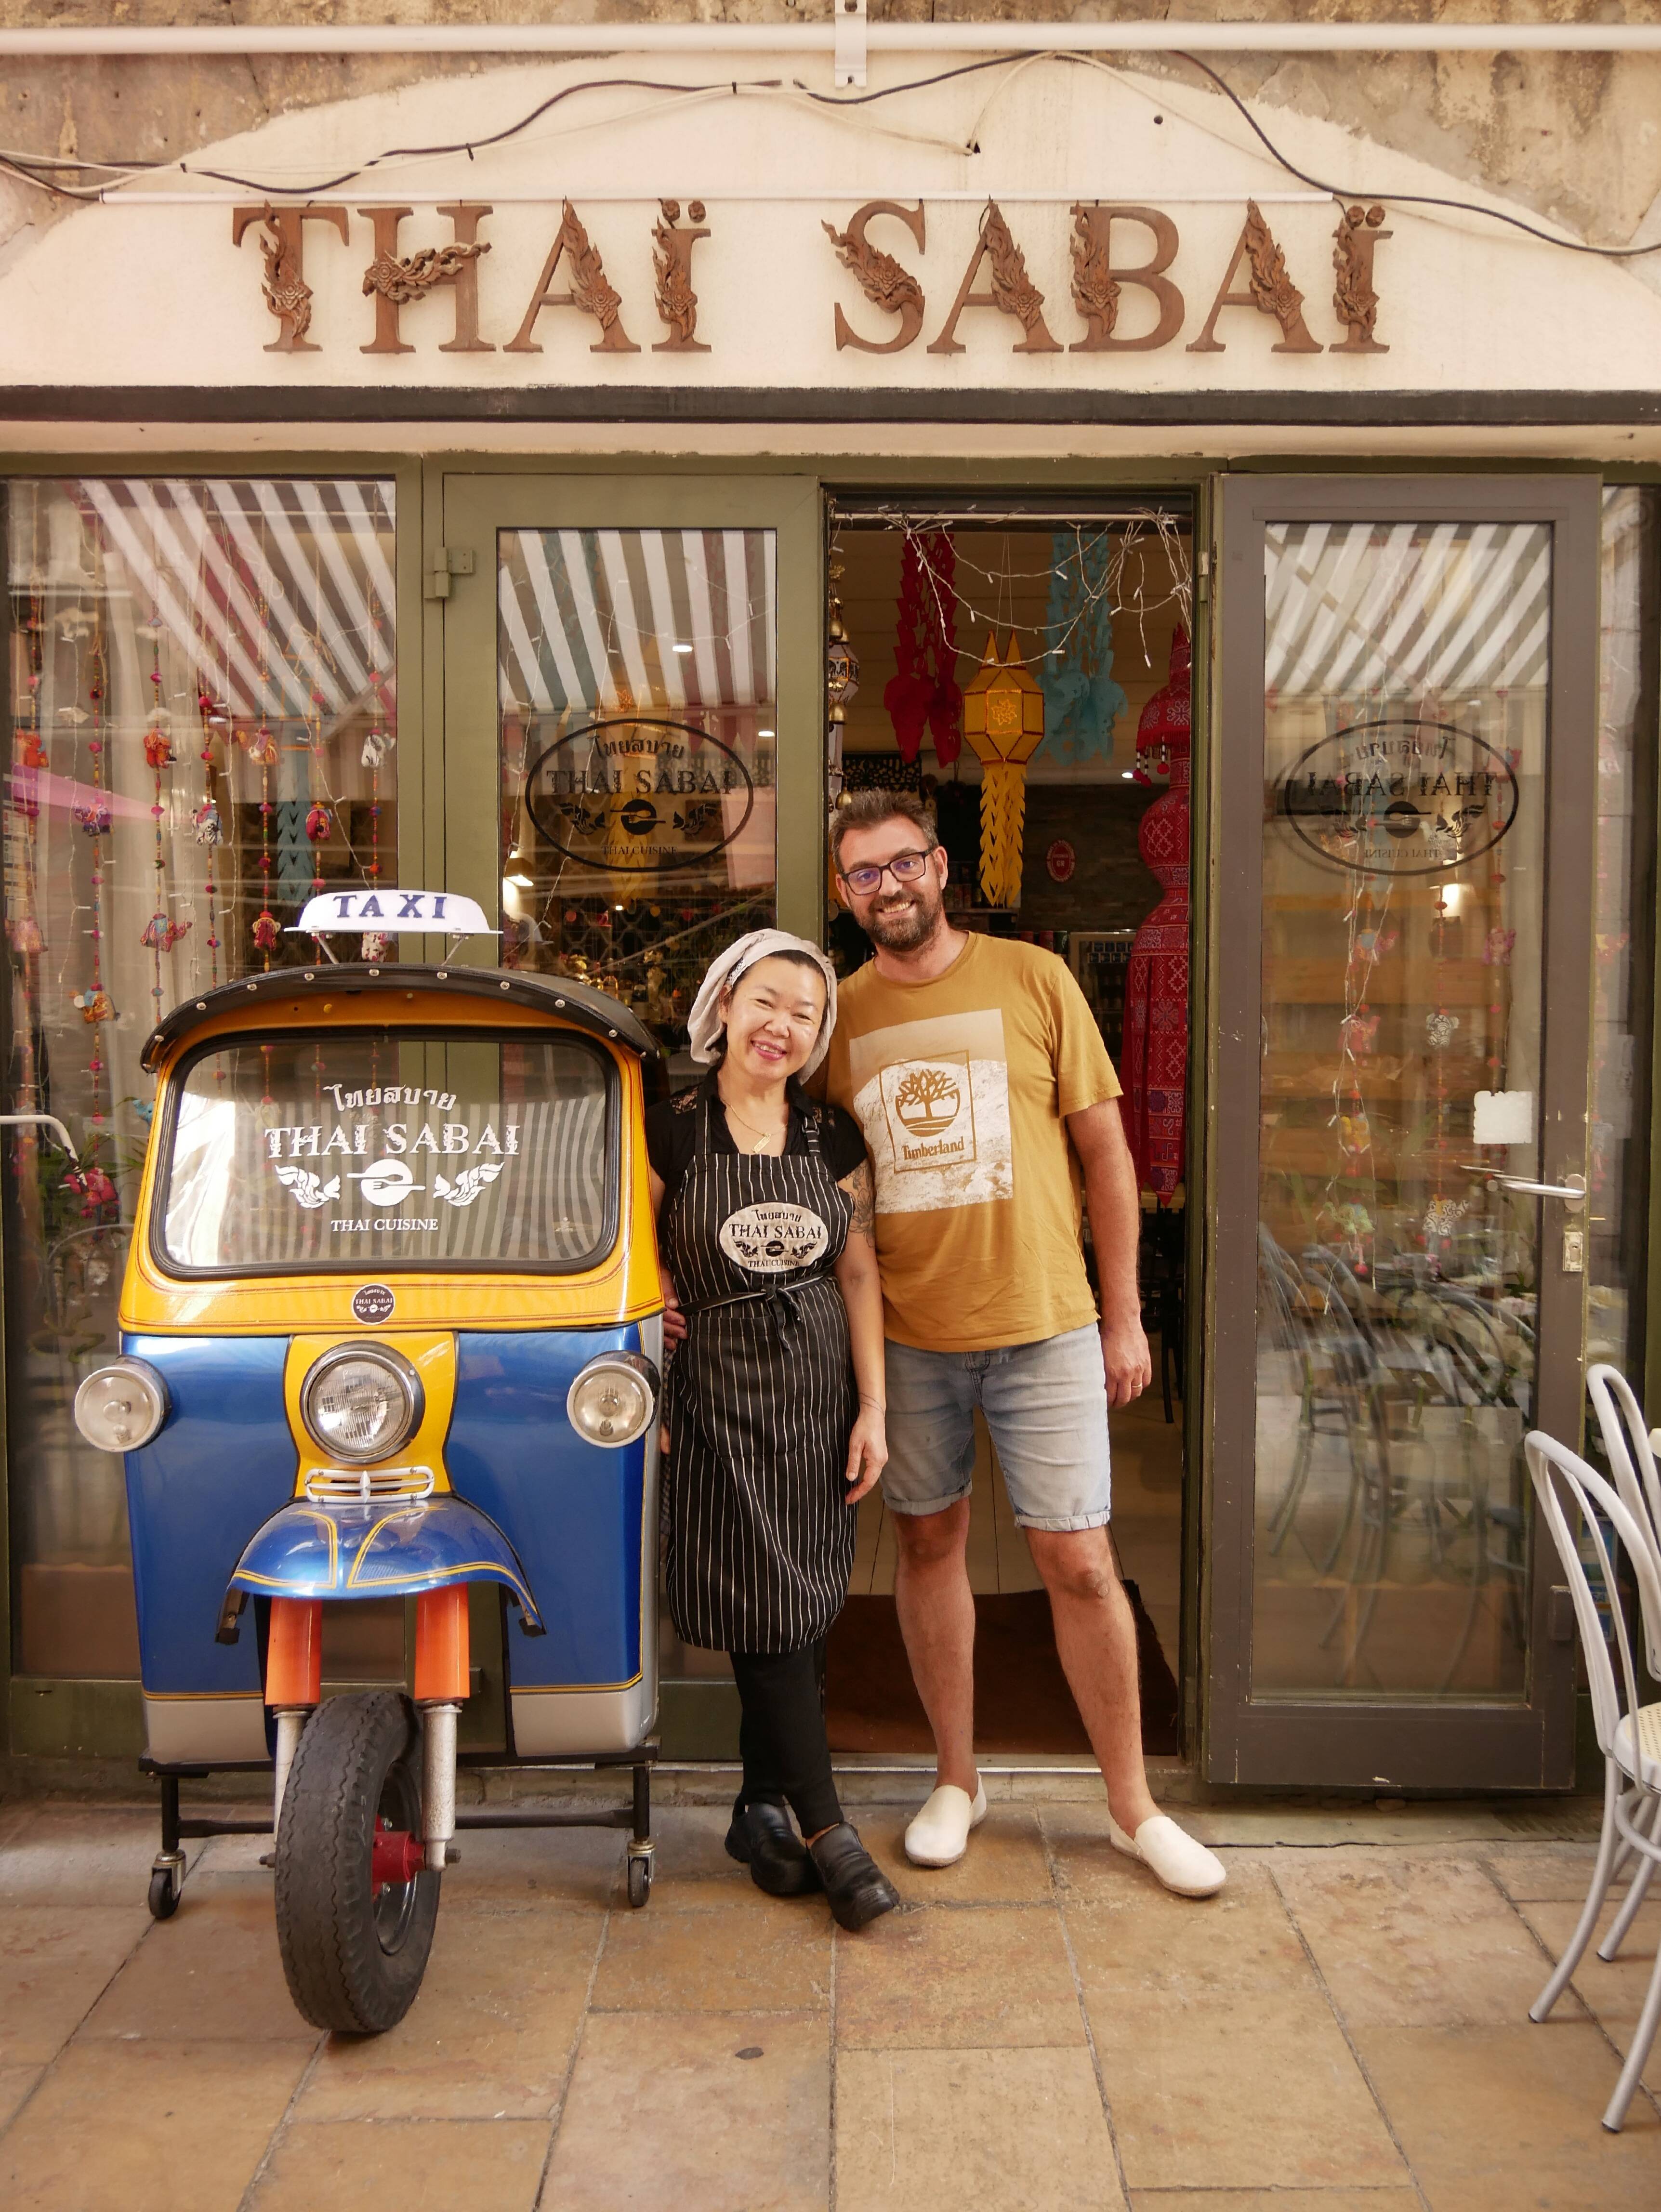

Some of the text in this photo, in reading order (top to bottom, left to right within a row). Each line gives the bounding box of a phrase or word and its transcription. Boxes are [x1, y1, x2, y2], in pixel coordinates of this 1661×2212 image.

[233, 195, 1394, 354] THAÏ SABAÏ
[546, 770, 733, 795] THAI SABAI
[602, 846, 629, 855] THAI
[333, 894, 447, 919] TAXI
[323, 1084, 457, 1111] ไทยสบาย
[265, 1123, 520, 1158] THAI SABAI
[901, 1136, 964, 1160] Timberland
[331, 1219, 438, 1232] THAI CUISINE
[729, 1224, 821, 1239] THAI SABAI
